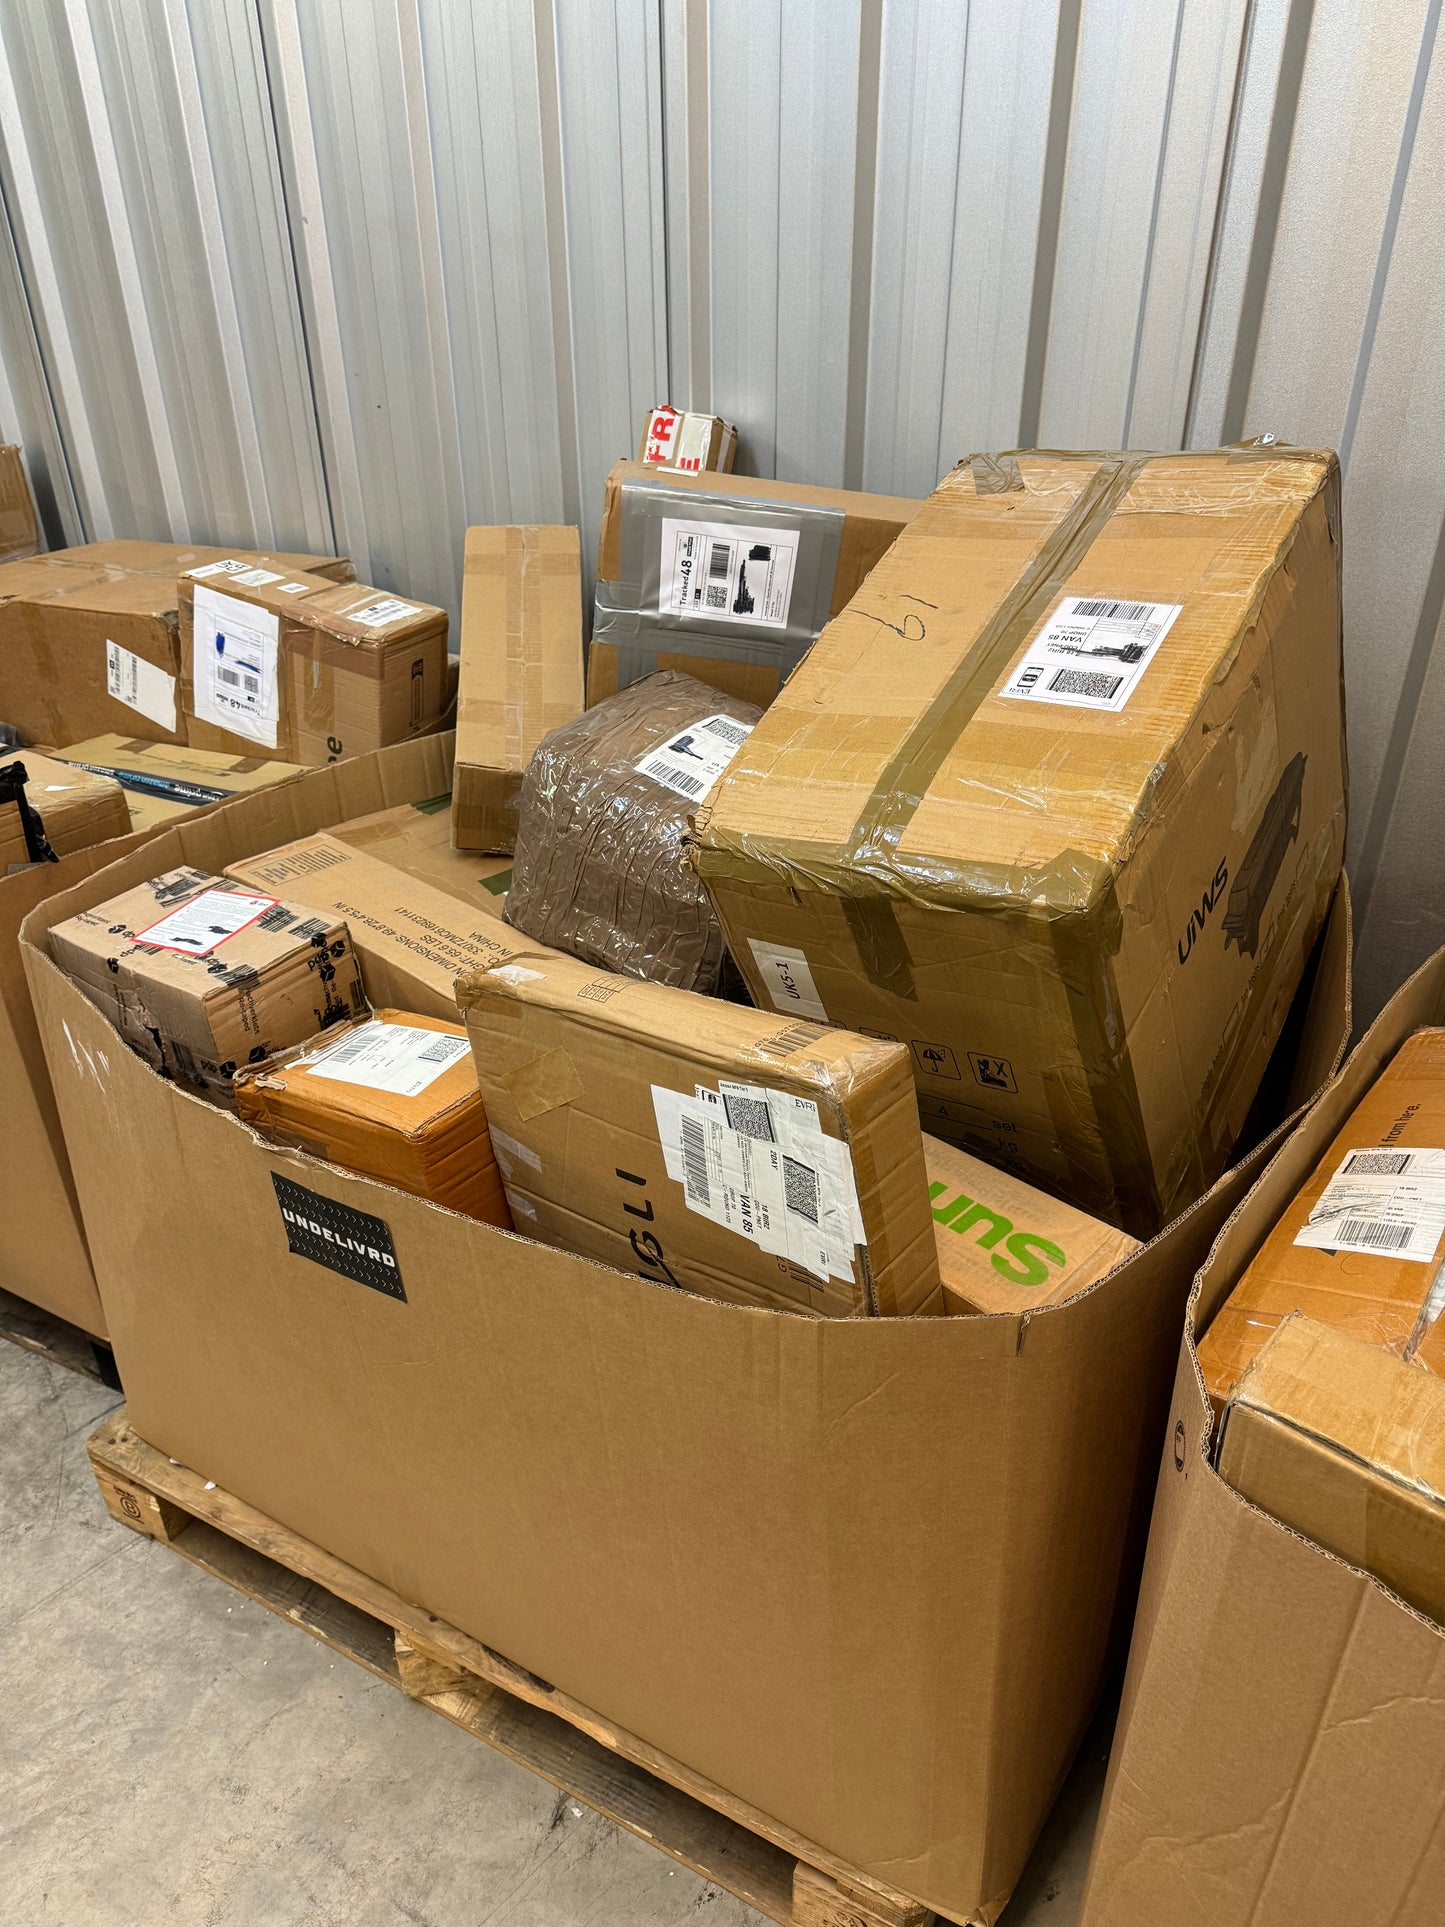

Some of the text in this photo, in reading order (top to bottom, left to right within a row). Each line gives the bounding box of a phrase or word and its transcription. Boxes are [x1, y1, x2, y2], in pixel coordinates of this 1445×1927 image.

[679, 559, 693, 606] Tracked 48
[1061, 635, 1082, 643] VAN
[229, 698, 241, 710] 48
[141, 774, 171, 790] amazon
[419, 934, 440, 948] LBS
[468, 931, 514, 957] IN CHINA
[775, 962, 801, 1000] UK5-1
[992, 1119, 1019, 1133] set
[1381, 1122, 1405, 1142] from
[998, 1137, 1018, 1154] kg
[770, 1149, 779, 1171] 2DAY
[740, 1194, 750, 1217] VAN
[742, 1218, 754, 1234] 85
[282, 1208, 396, 1268] UNDELIVRD
